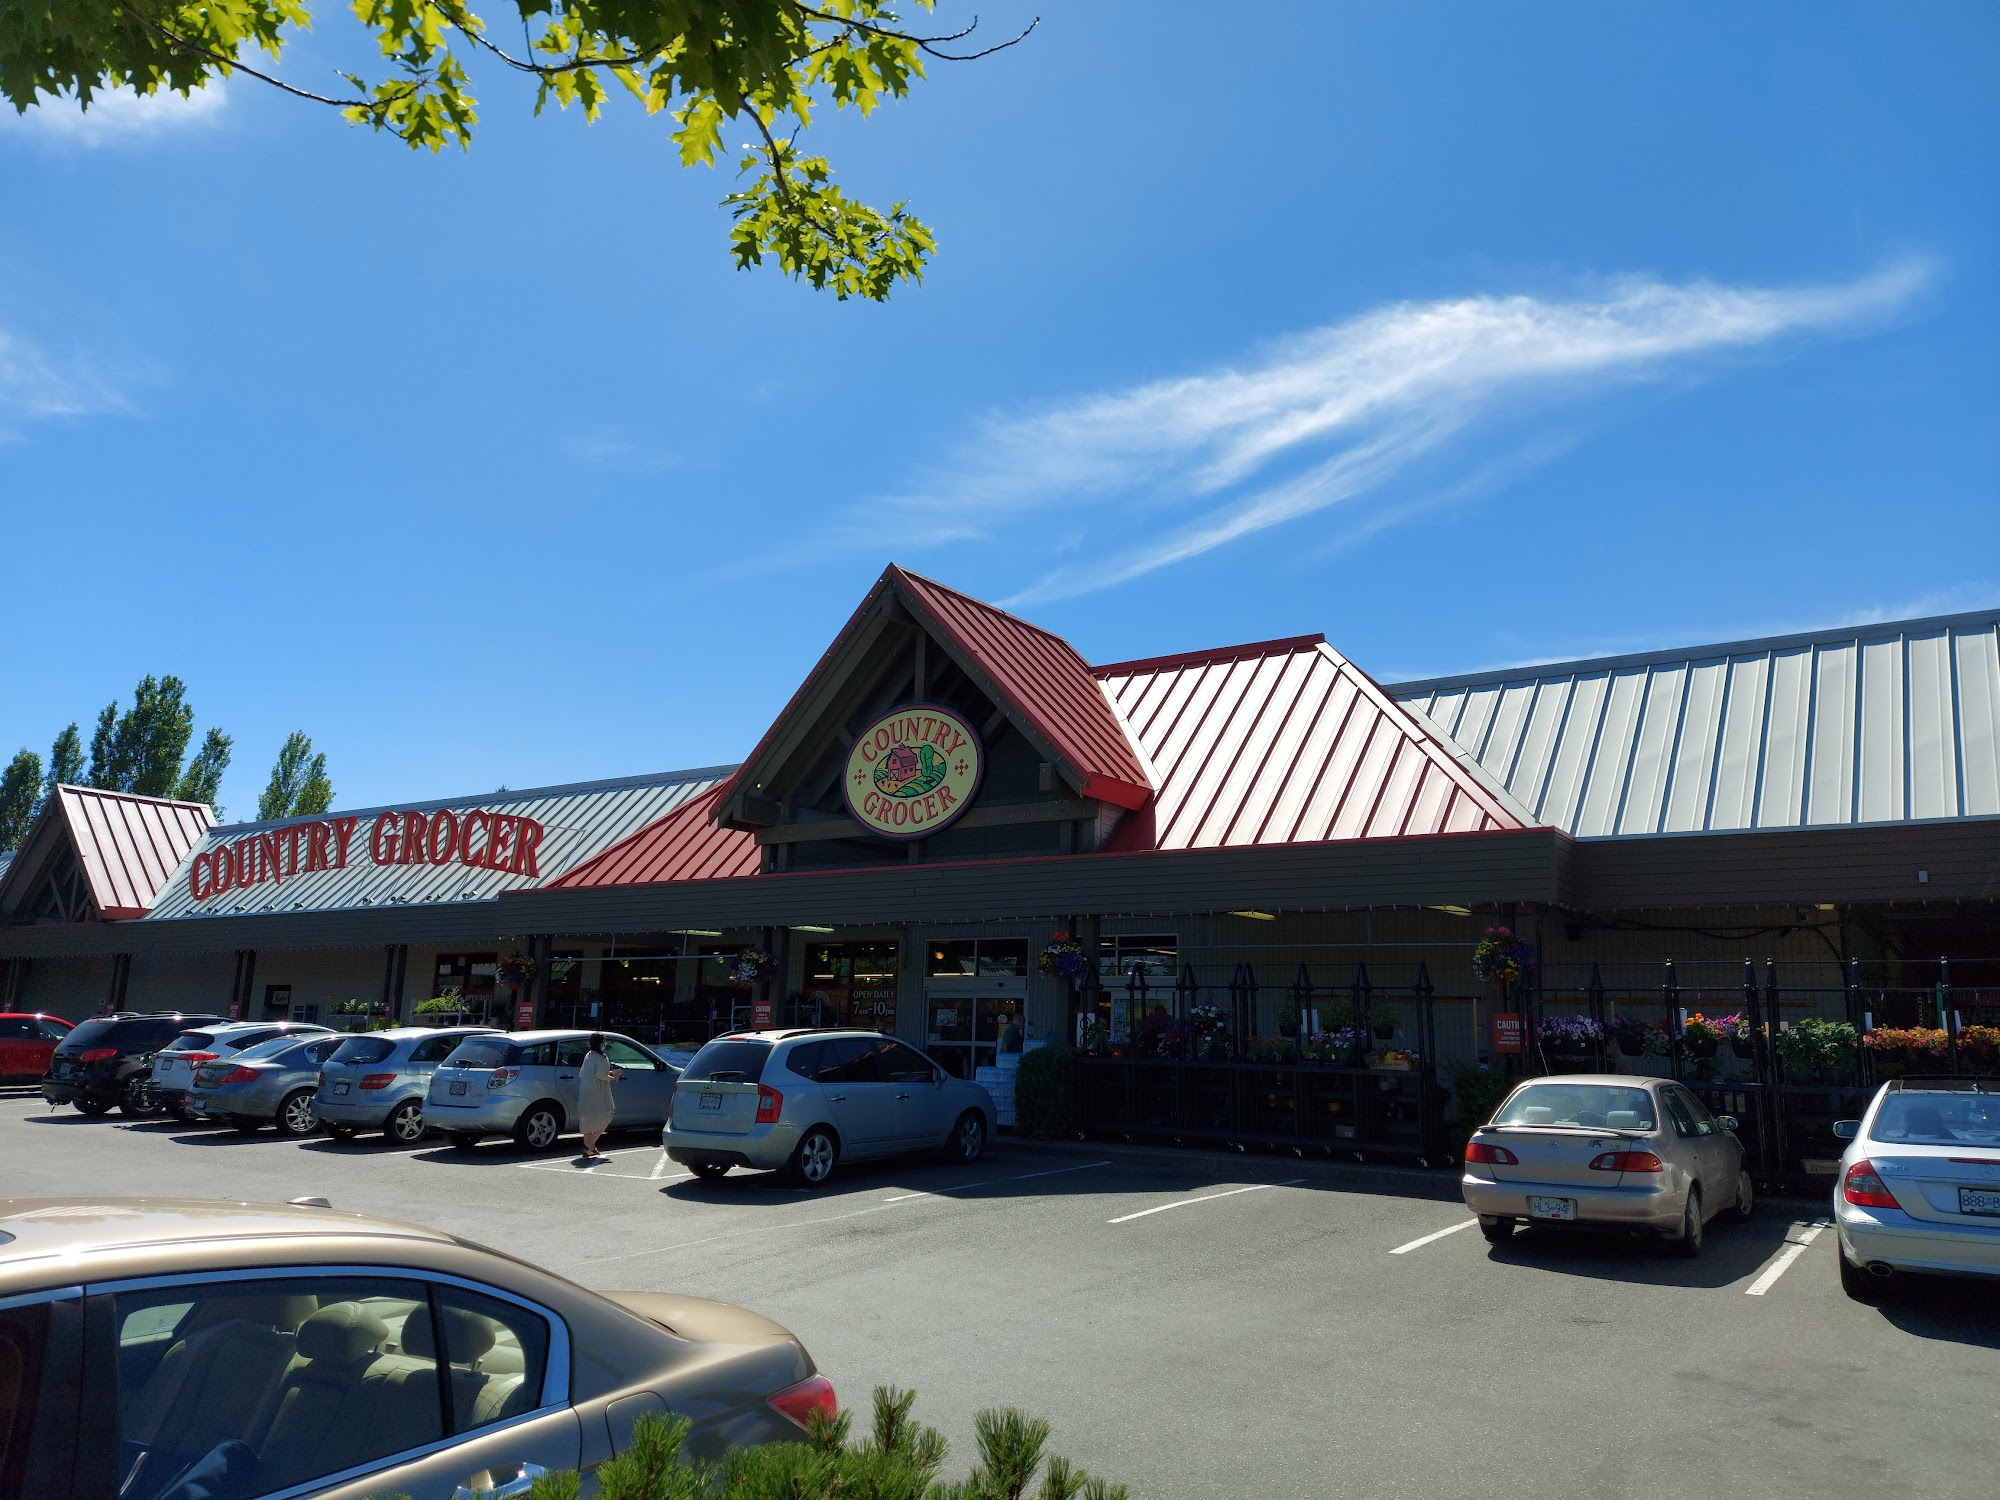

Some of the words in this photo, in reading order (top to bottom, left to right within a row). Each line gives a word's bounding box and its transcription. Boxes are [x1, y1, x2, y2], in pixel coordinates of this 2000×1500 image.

[861, 716, 967, 762] COUNTRY
[863, 785, 958, 826] GROCER
[189, 815, 358, 900] COUNTRY
[369, 808, 544, 878] GROCER
[853, 990, 871, 999] OPEN
[874, 990, 895, 999] DAILY
[1962, 1194, 1985, 1208] 888
